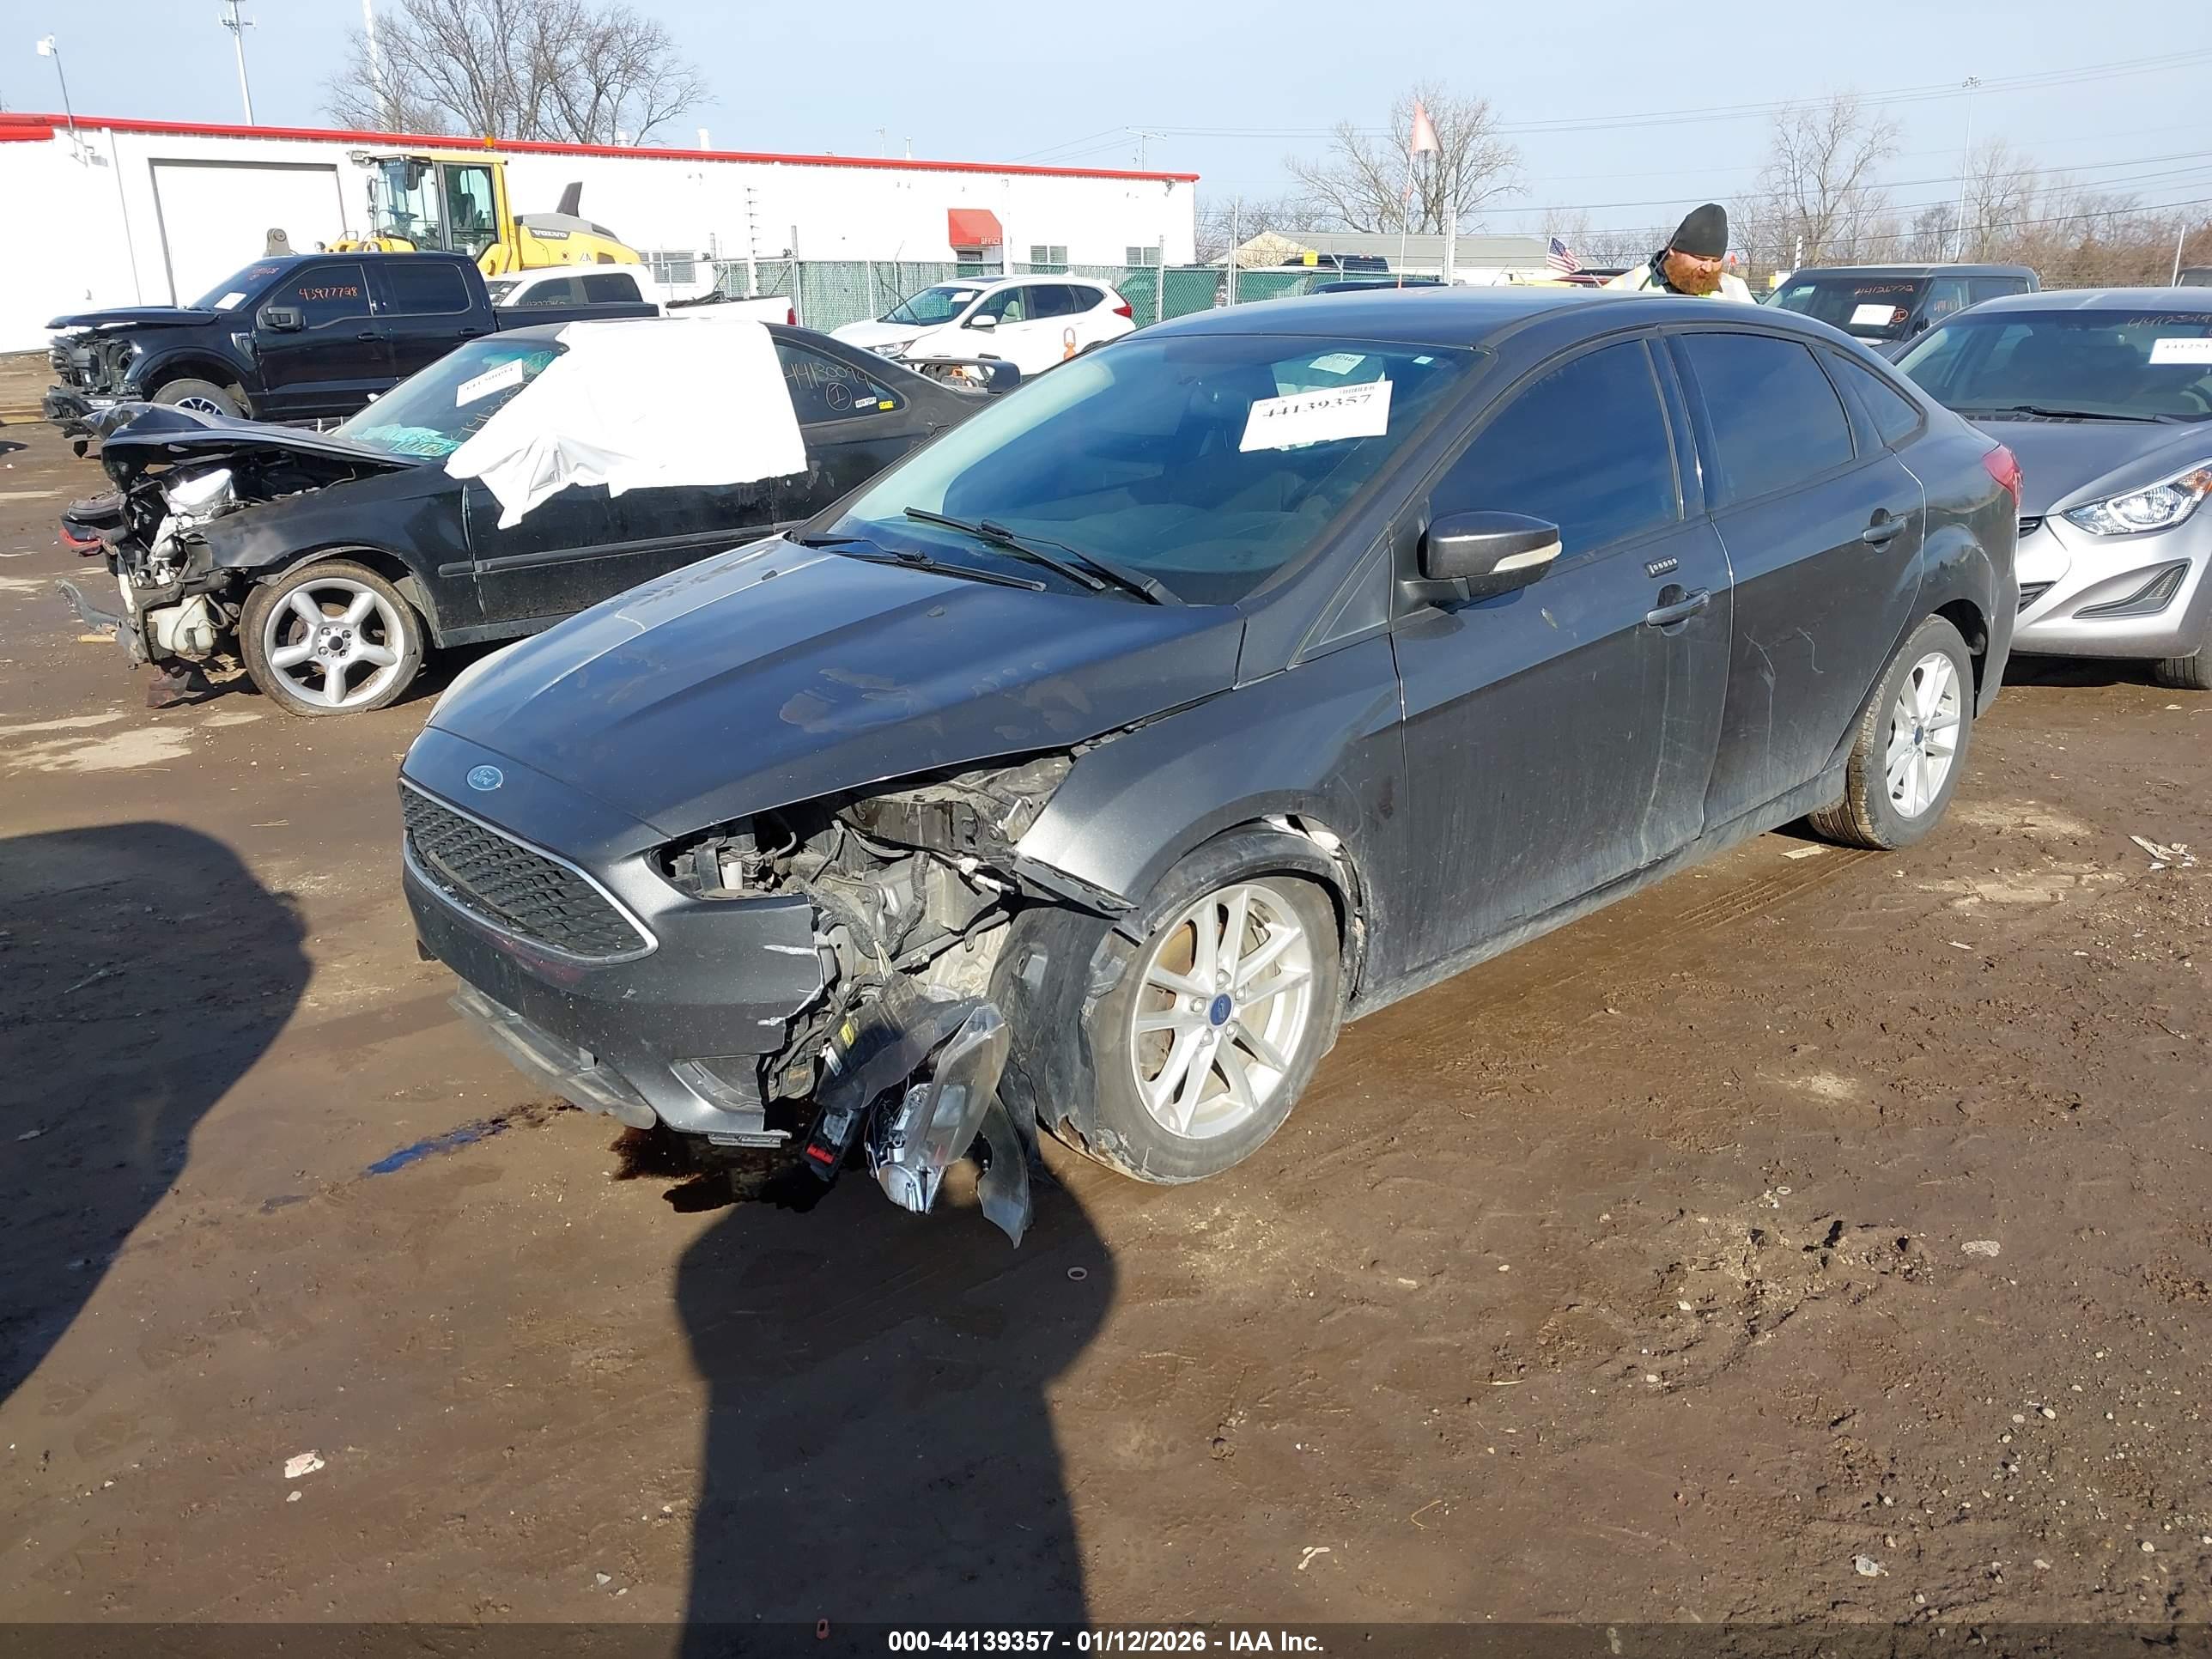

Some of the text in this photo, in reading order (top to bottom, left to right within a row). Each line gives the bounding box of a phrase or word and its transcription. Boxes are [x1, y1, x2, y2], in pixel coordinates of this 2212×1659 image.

[532, 229, 567, 238] VOLVO
[298, 287, 358, 301] 43977728
[1261, 393, 1372, 418] 44139357
